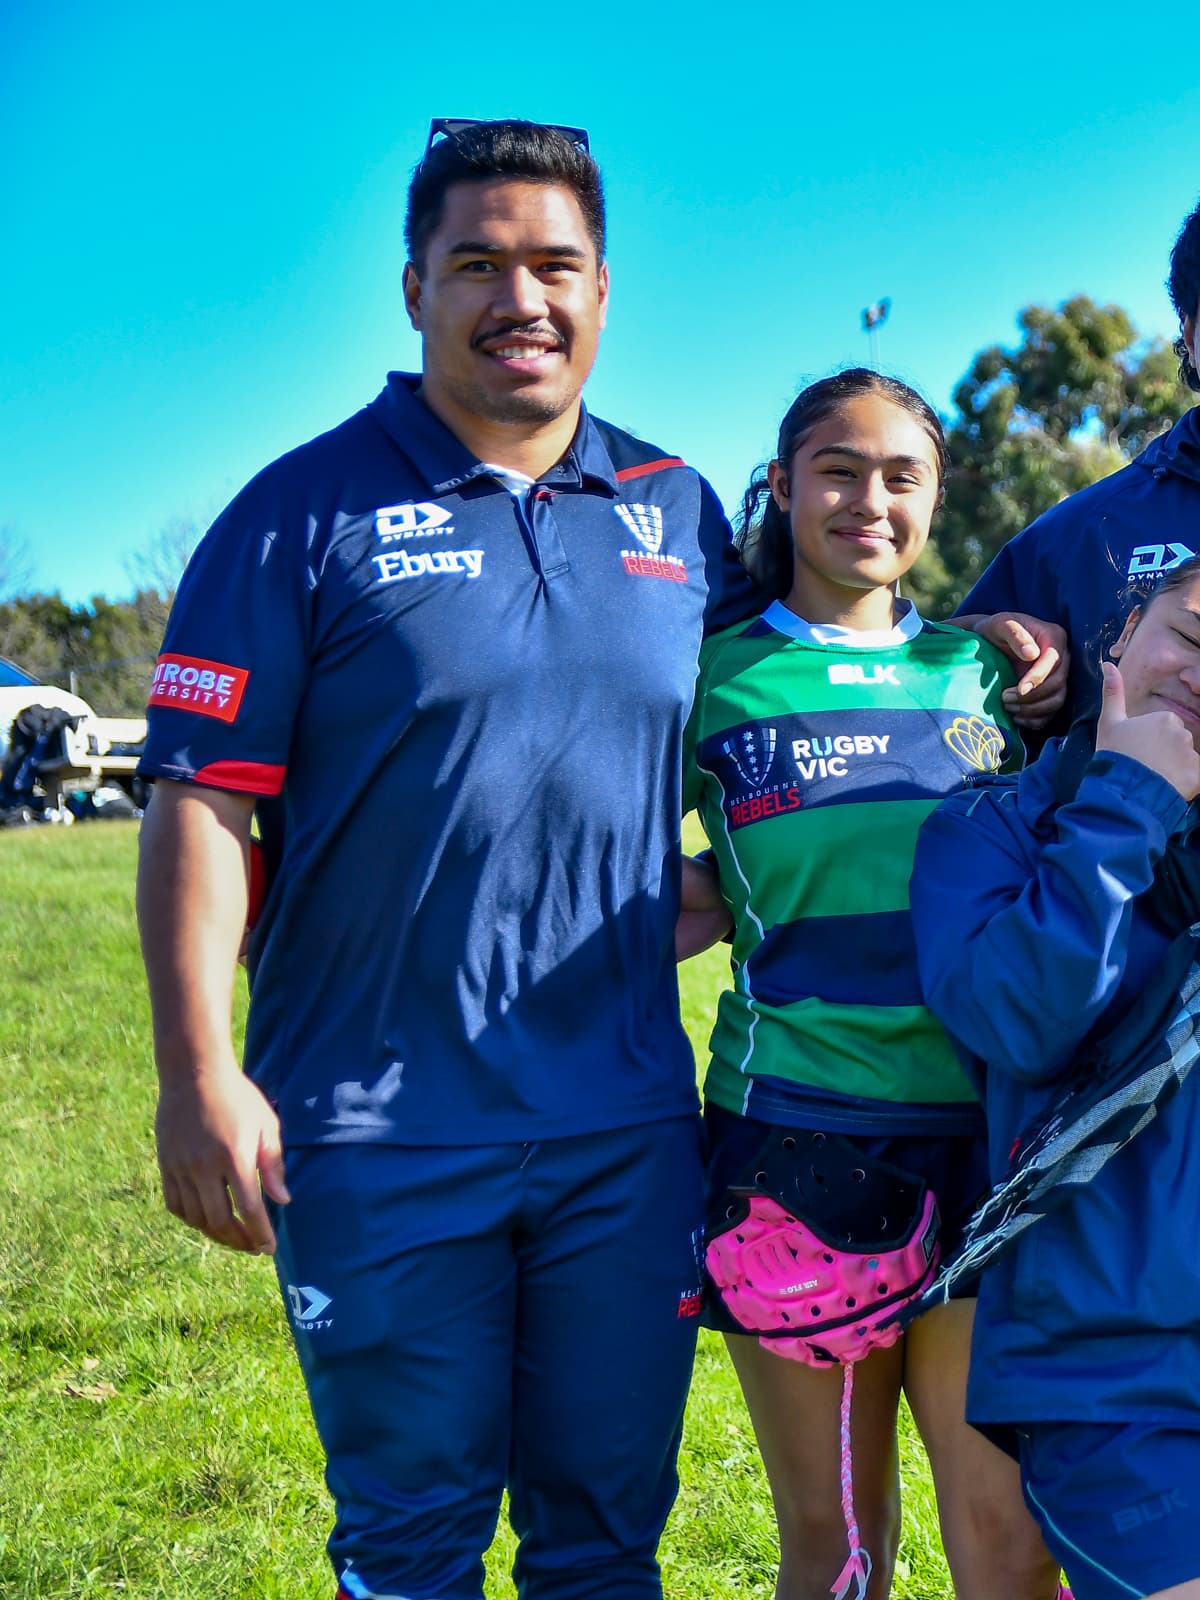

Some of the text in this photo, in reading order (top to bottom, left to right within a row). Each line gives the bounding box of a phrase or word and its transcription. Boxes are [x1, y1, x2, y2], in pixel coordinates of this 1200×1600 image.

[372, 549, 485, 583] Ebury
[623, 556, 688, 583] REBELS
[1127, 570, 1165, 582] DYNA
[828, 664, 901, 685] BLK
[152, 683, 230, 708] ERSITY
[792, 735, 890, 760] RUGBY
[796, 757, 849, 780] VIC
[730, 780, 798, 807] MELBOURNE
[731, 787, 801, 827] REBELS
[1111, 1487, 1189, 1535] BLK
